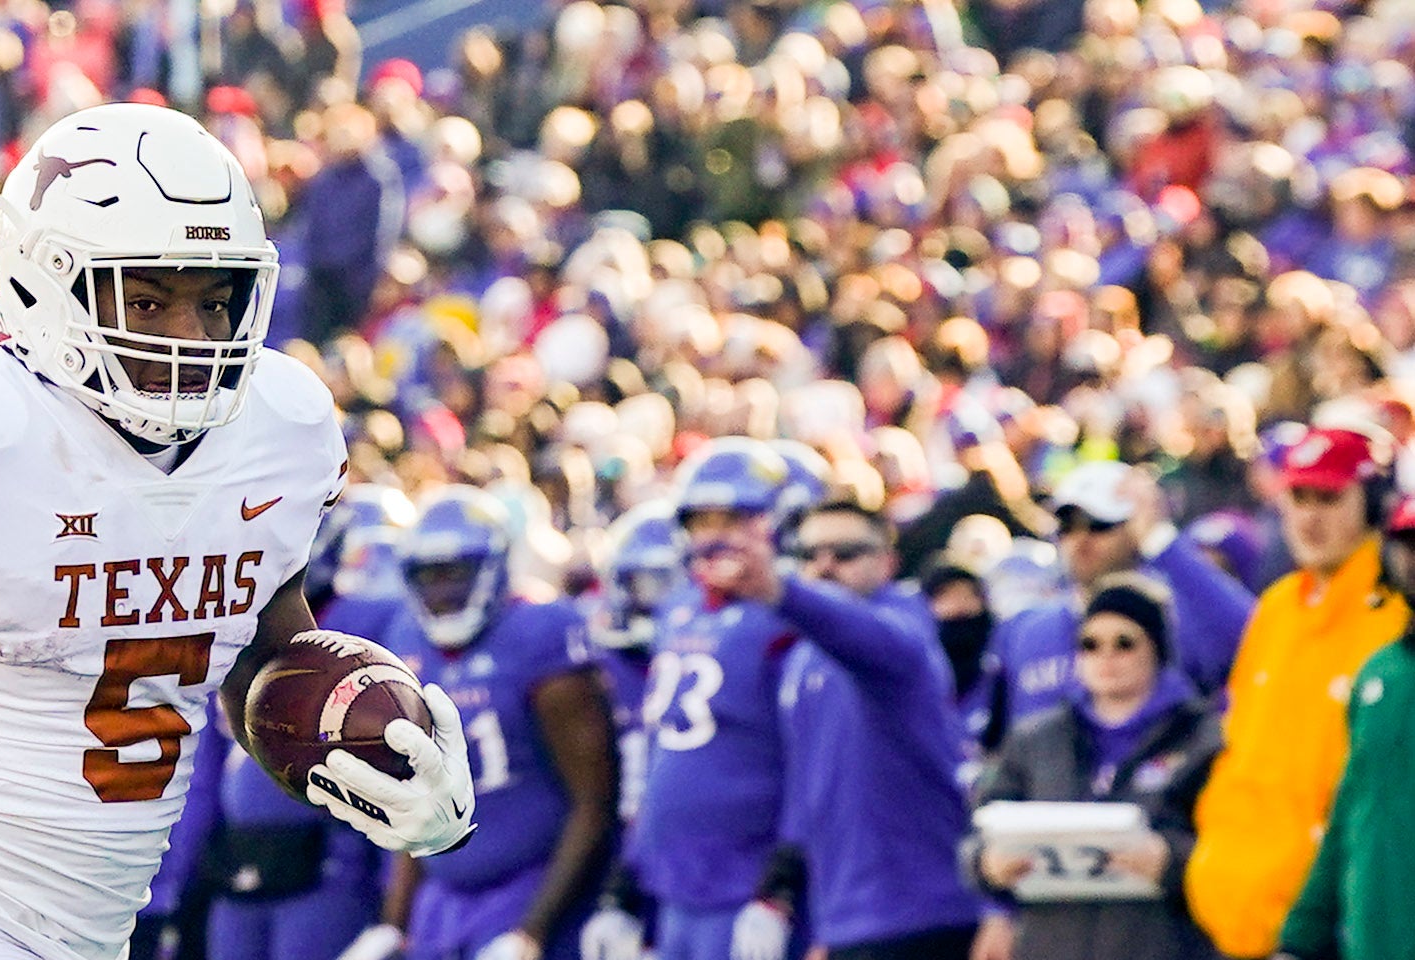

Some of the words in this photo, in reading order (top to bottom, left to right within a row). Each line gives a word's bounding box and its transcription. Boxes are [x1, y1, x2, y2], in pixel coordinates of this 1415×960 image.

[185, 226, 231, 241] HORNS
[54, 550, 264, 629] TEXAS
[83, 632, 216, 803] 5
